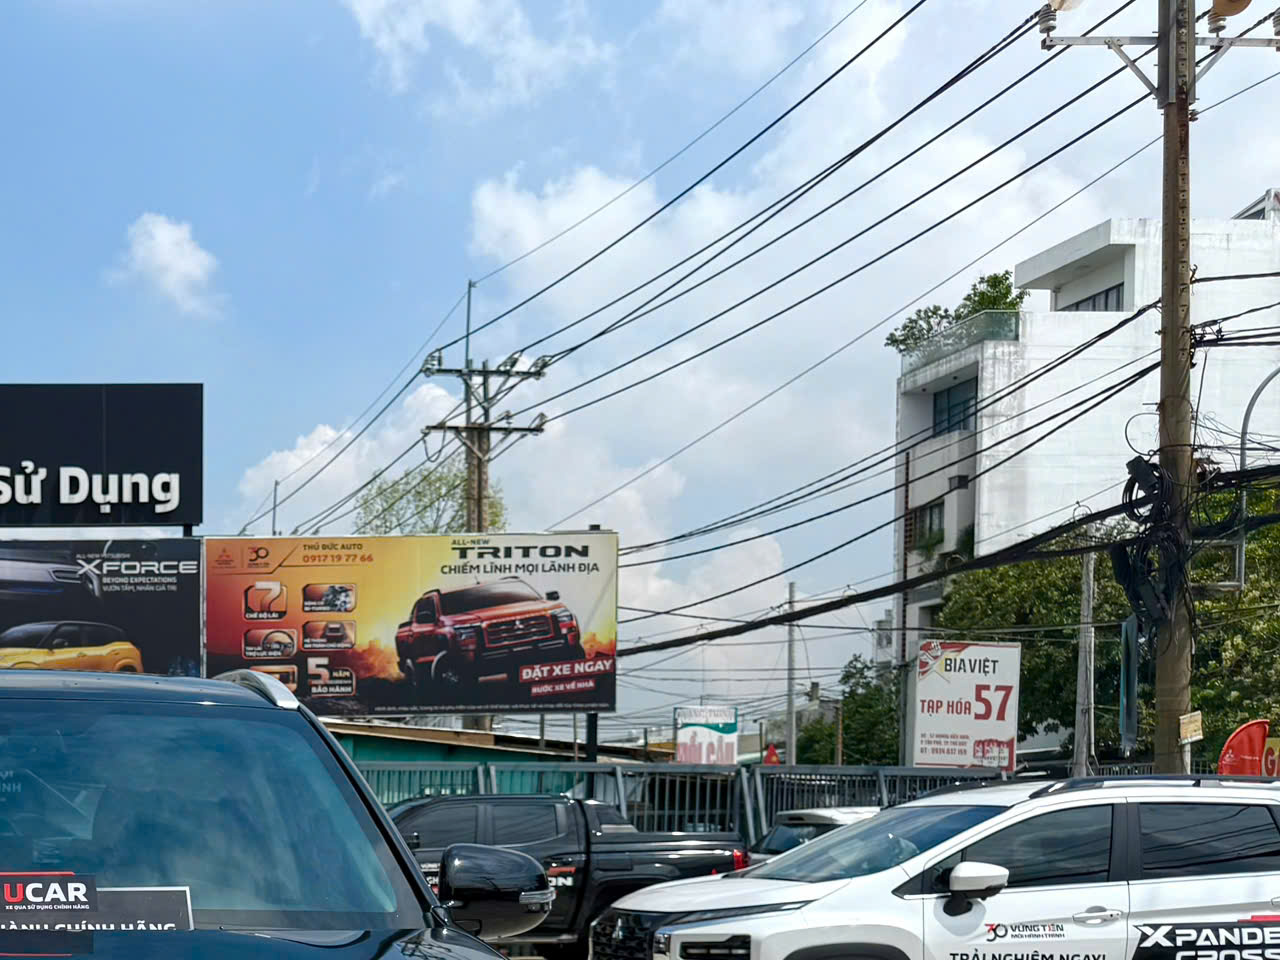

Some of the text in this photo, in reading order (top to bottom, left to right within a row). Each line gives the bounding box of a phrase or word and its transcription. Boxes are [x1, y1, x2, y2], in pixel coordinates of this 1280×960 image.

[59, 466, 180, 513] Dụng
[303, 542, 320, 550] THỦ
[321, 542, 339, 550] ĐỨC
[451, 545, 589, 559] TRITON
[76, 559, 198, 575] XFORCE
[303, 553, 374, 563] 0917 19 77 66
[440, 561, 480, 575] CHIẾM
[515, 563, 539, 576] MỌI
[541, 560, 575, 573] LÃNH
[579, 562, 600, 575] ĐỊA
[307, 657, 330, 684] 5
[522, 660, 613, 681] ĐẶT XE NGAY
[944, 656, 999, 676] BIA VIỆT
[920, 697, 971, 717] TẠP HÓA
[974, 684, 1013, 721] 57
[4, 882, 88, 903] UCAR
[1134, 925, 1280, 948] XPANDE
